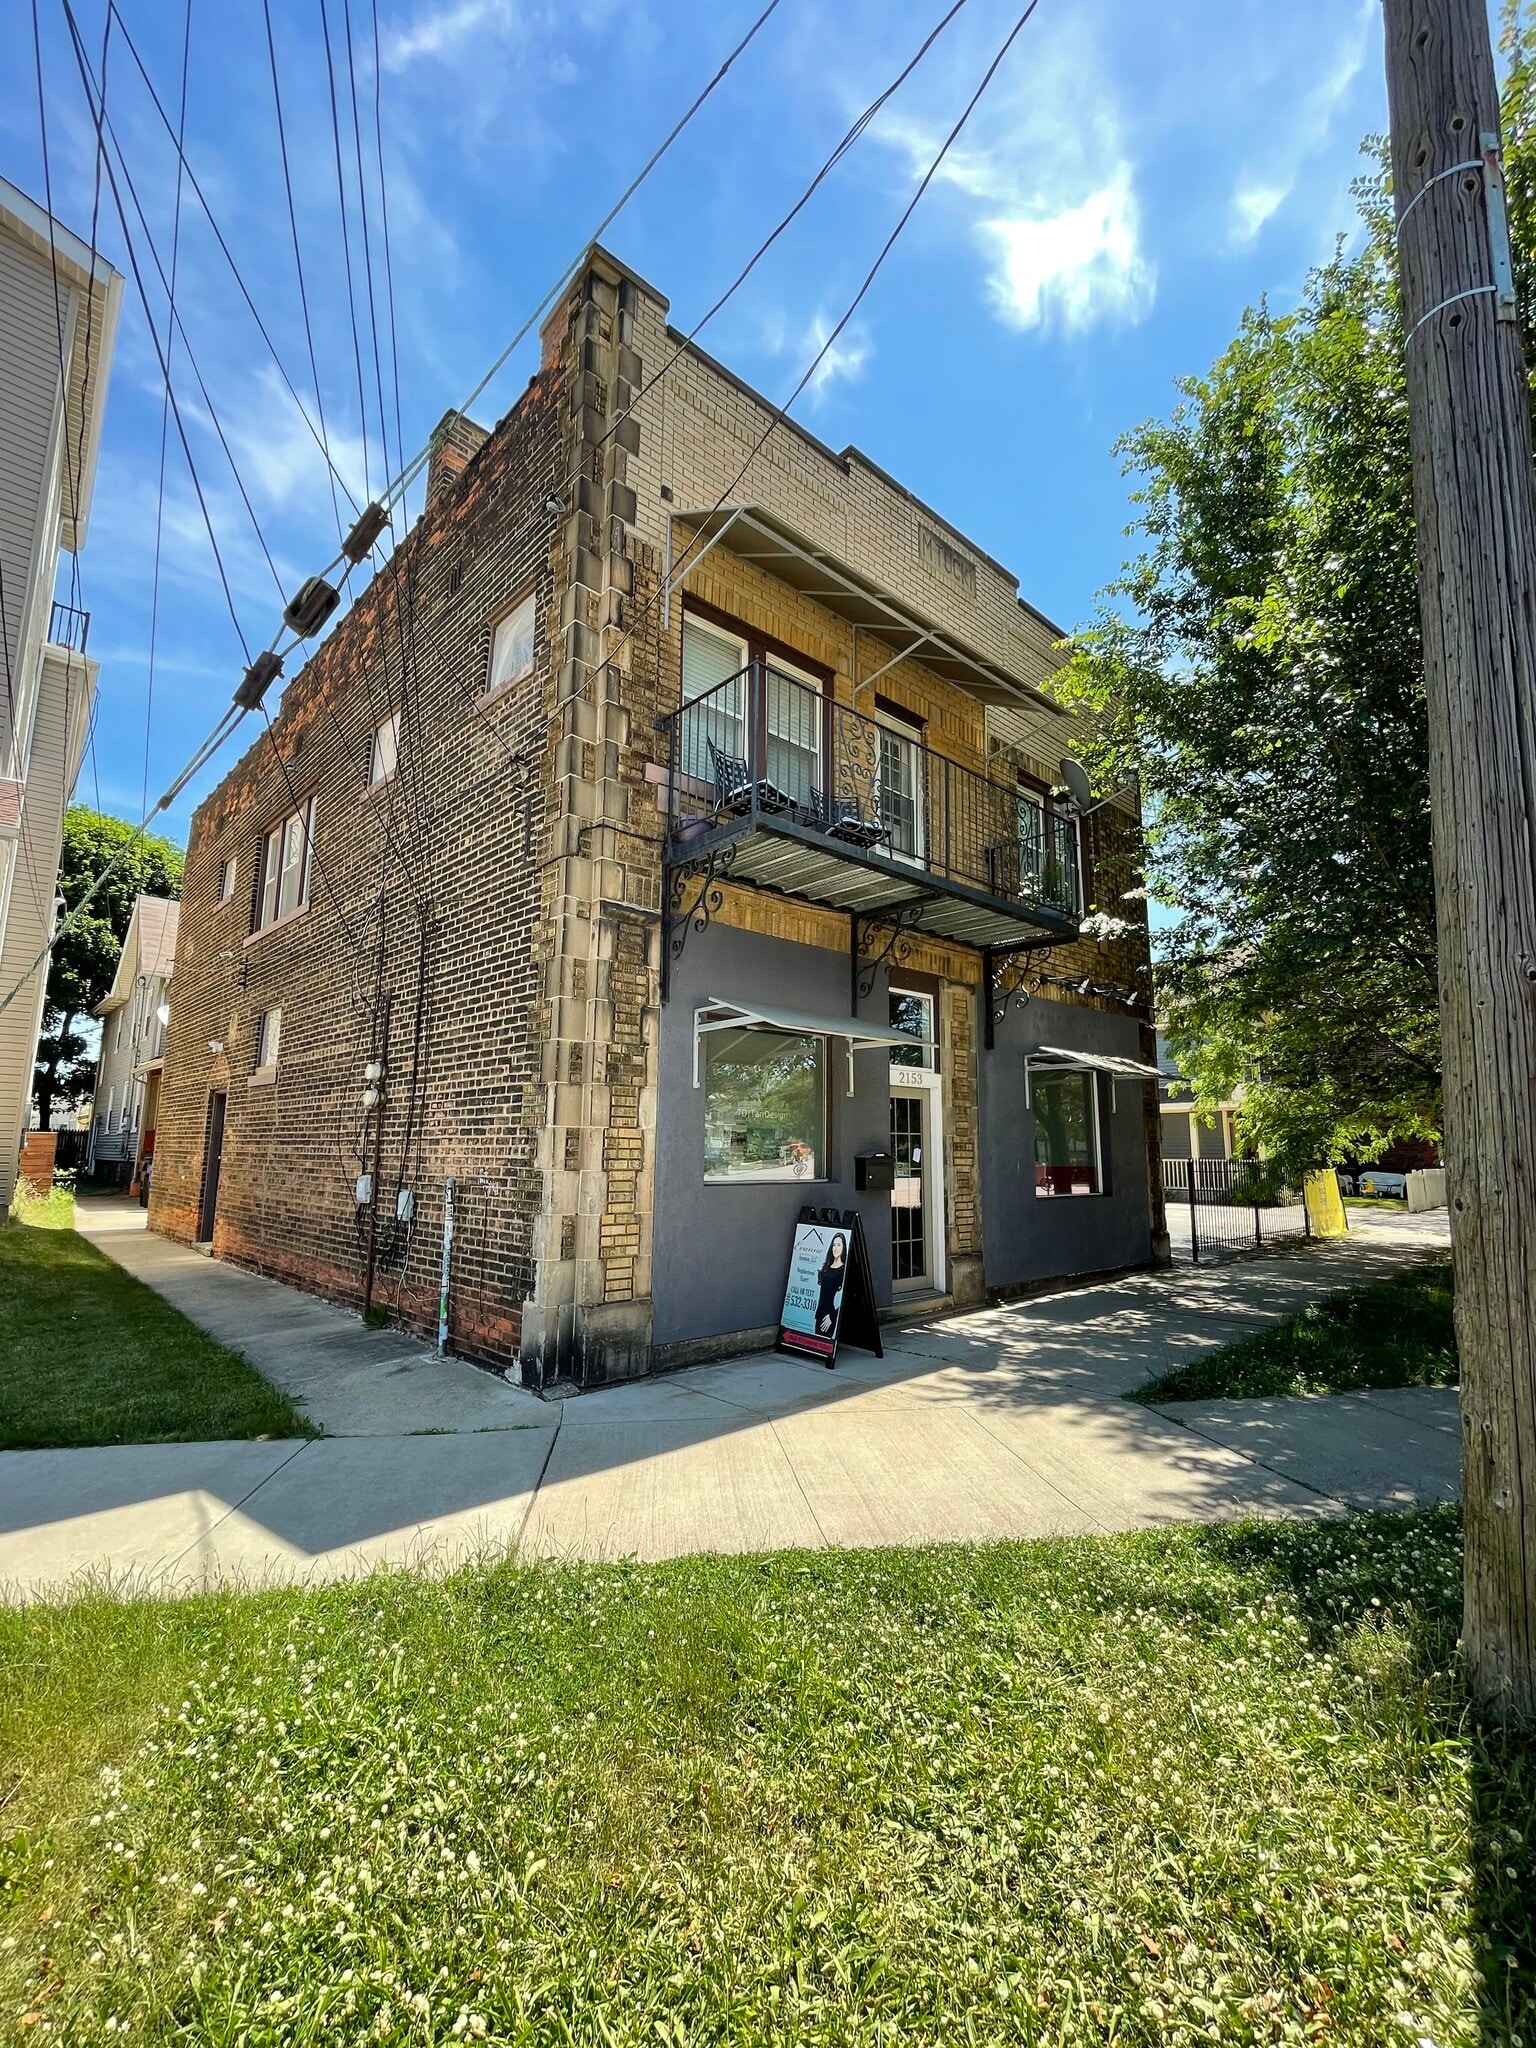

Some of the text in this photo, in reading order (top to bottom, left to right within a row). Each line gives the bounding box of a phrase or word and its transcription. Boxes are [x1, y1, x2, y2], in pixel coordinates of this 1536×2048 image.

[899, 1071, 923, 1085] 2153
[793, 1241, 823, 1254] Evanne
[790, 1286, 815, 1297] CALL OR TEXT
[790, 1295, 817, 1311] 532-3310
